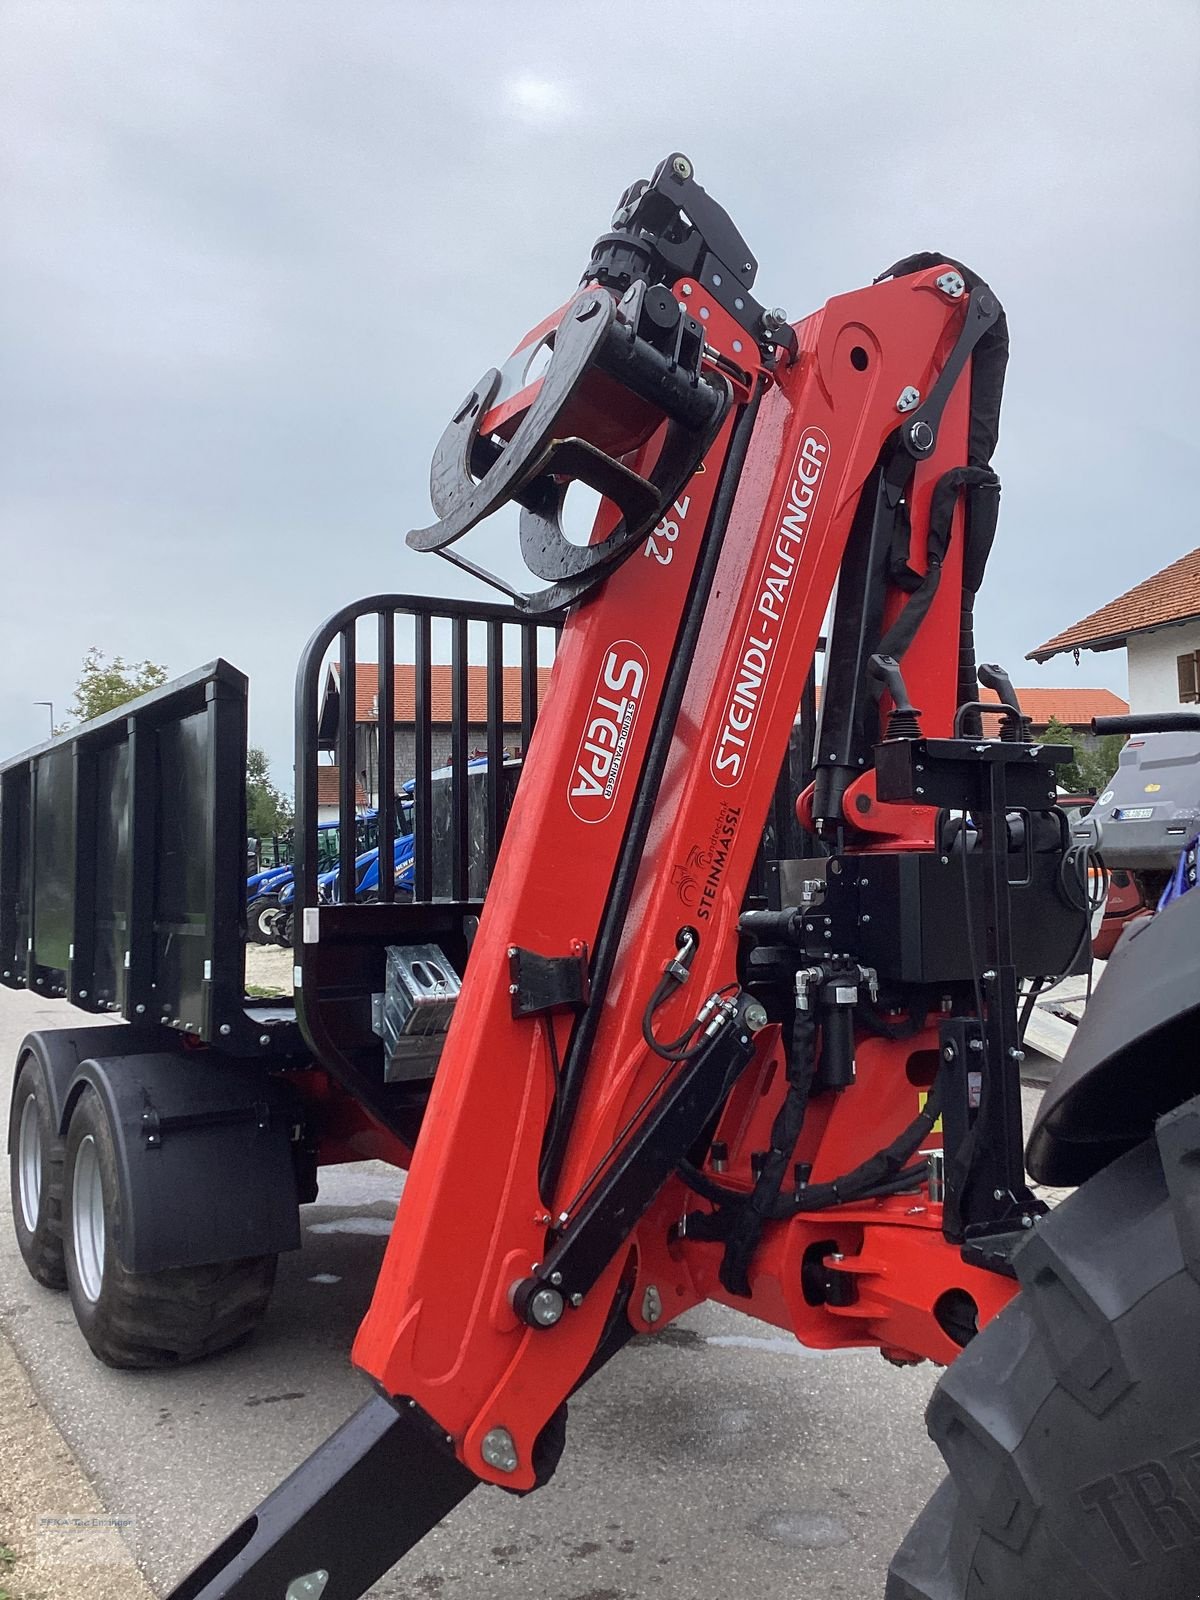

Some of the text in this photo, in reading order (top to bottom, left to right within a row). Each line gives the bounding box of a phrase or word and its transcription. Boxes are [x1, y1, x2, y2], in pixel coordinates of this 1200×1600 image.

[716, 436, 827, 777] STEINDL-PALFINGER
[571, 652, 644, 796] STEPA
[604, 703, 636, 798] STEINDL-PALFINGER
[697, 807, 741, 921] STEINMASSL
[703, 800, 729, 865] Landtechnik
